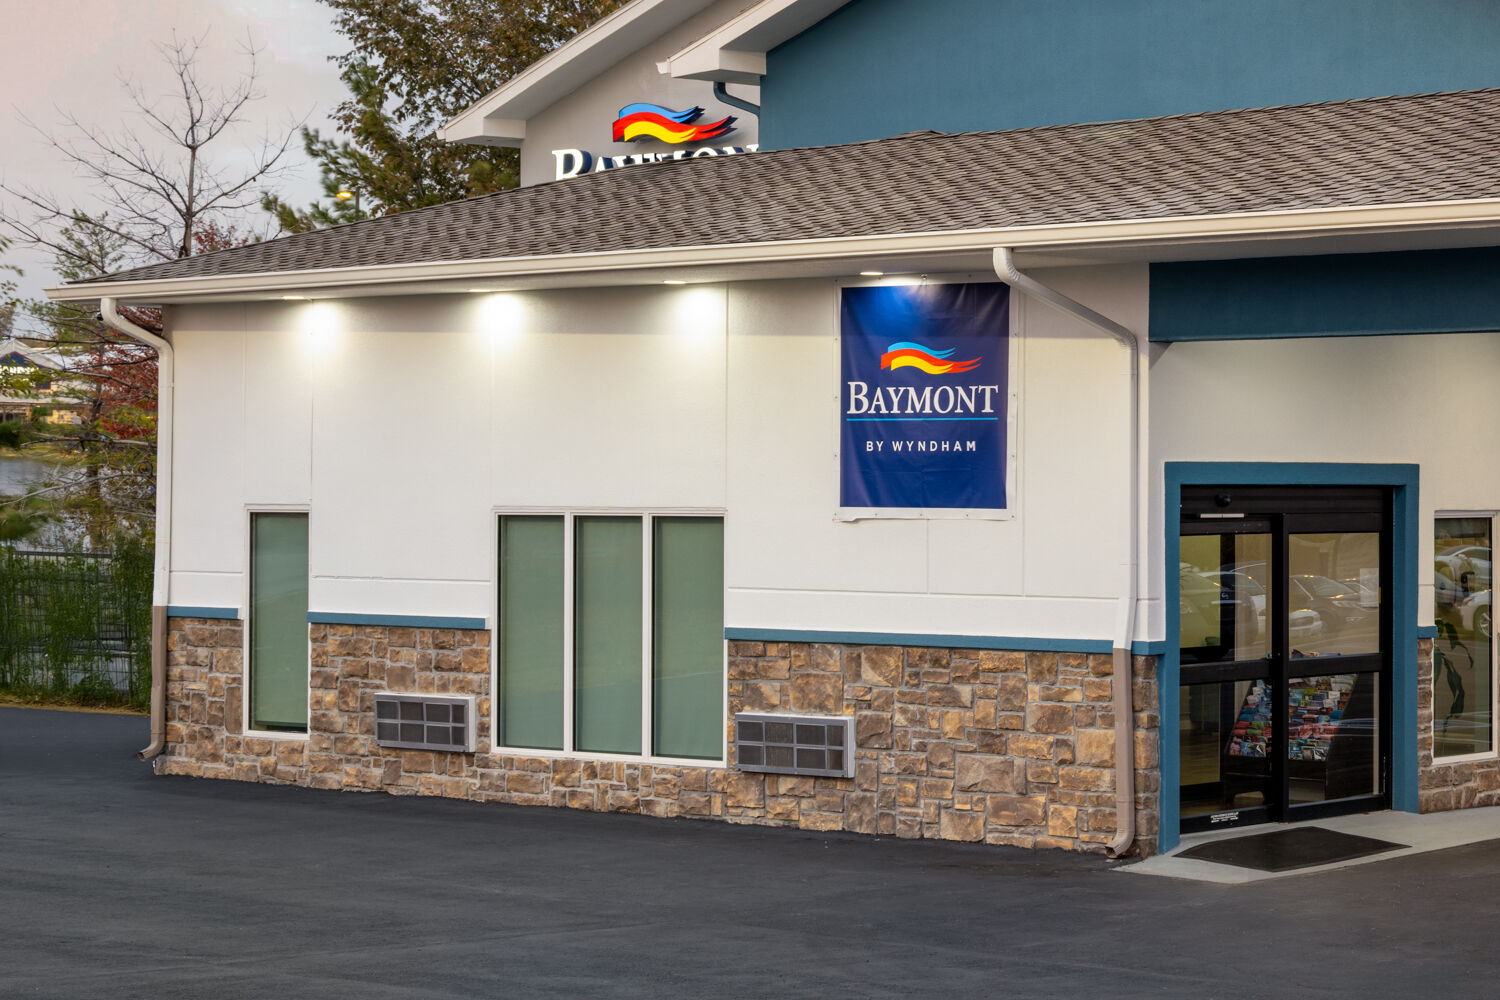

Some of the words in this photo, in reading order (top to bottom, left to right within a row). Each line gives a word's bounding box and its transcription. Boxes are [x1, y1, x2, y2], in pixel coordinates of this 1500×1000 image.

[846, 381, 999, 415] BAYMONT
[866, 441, 884, 452] BY
[892, 440, 977, 452] WYNDHAM
